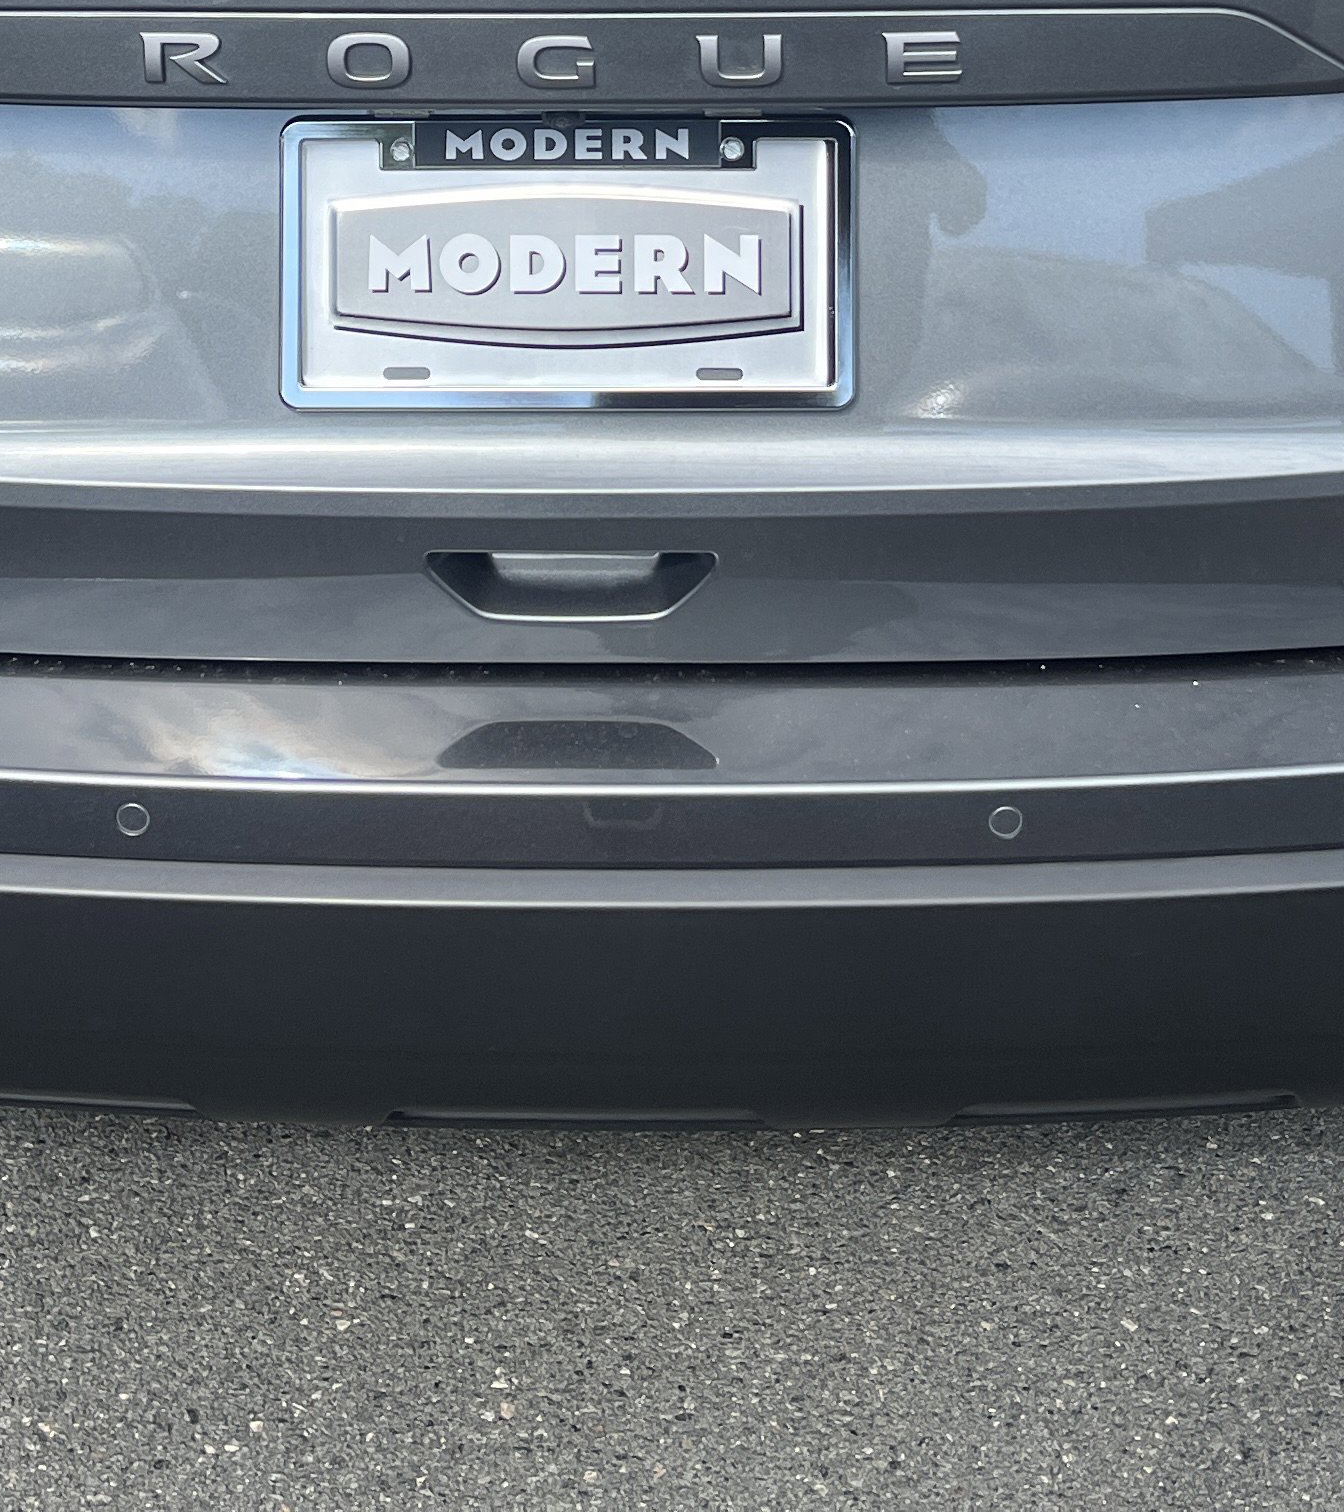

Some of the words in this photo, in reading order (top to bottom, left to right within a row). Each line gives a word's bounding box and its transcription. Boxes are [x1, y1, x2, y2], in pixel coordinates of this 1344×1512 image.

[139, 31, 963, 88] ROGUE
[444, 128, 690, 161] MODERN
[367, 233, 762, 294] MODERN
